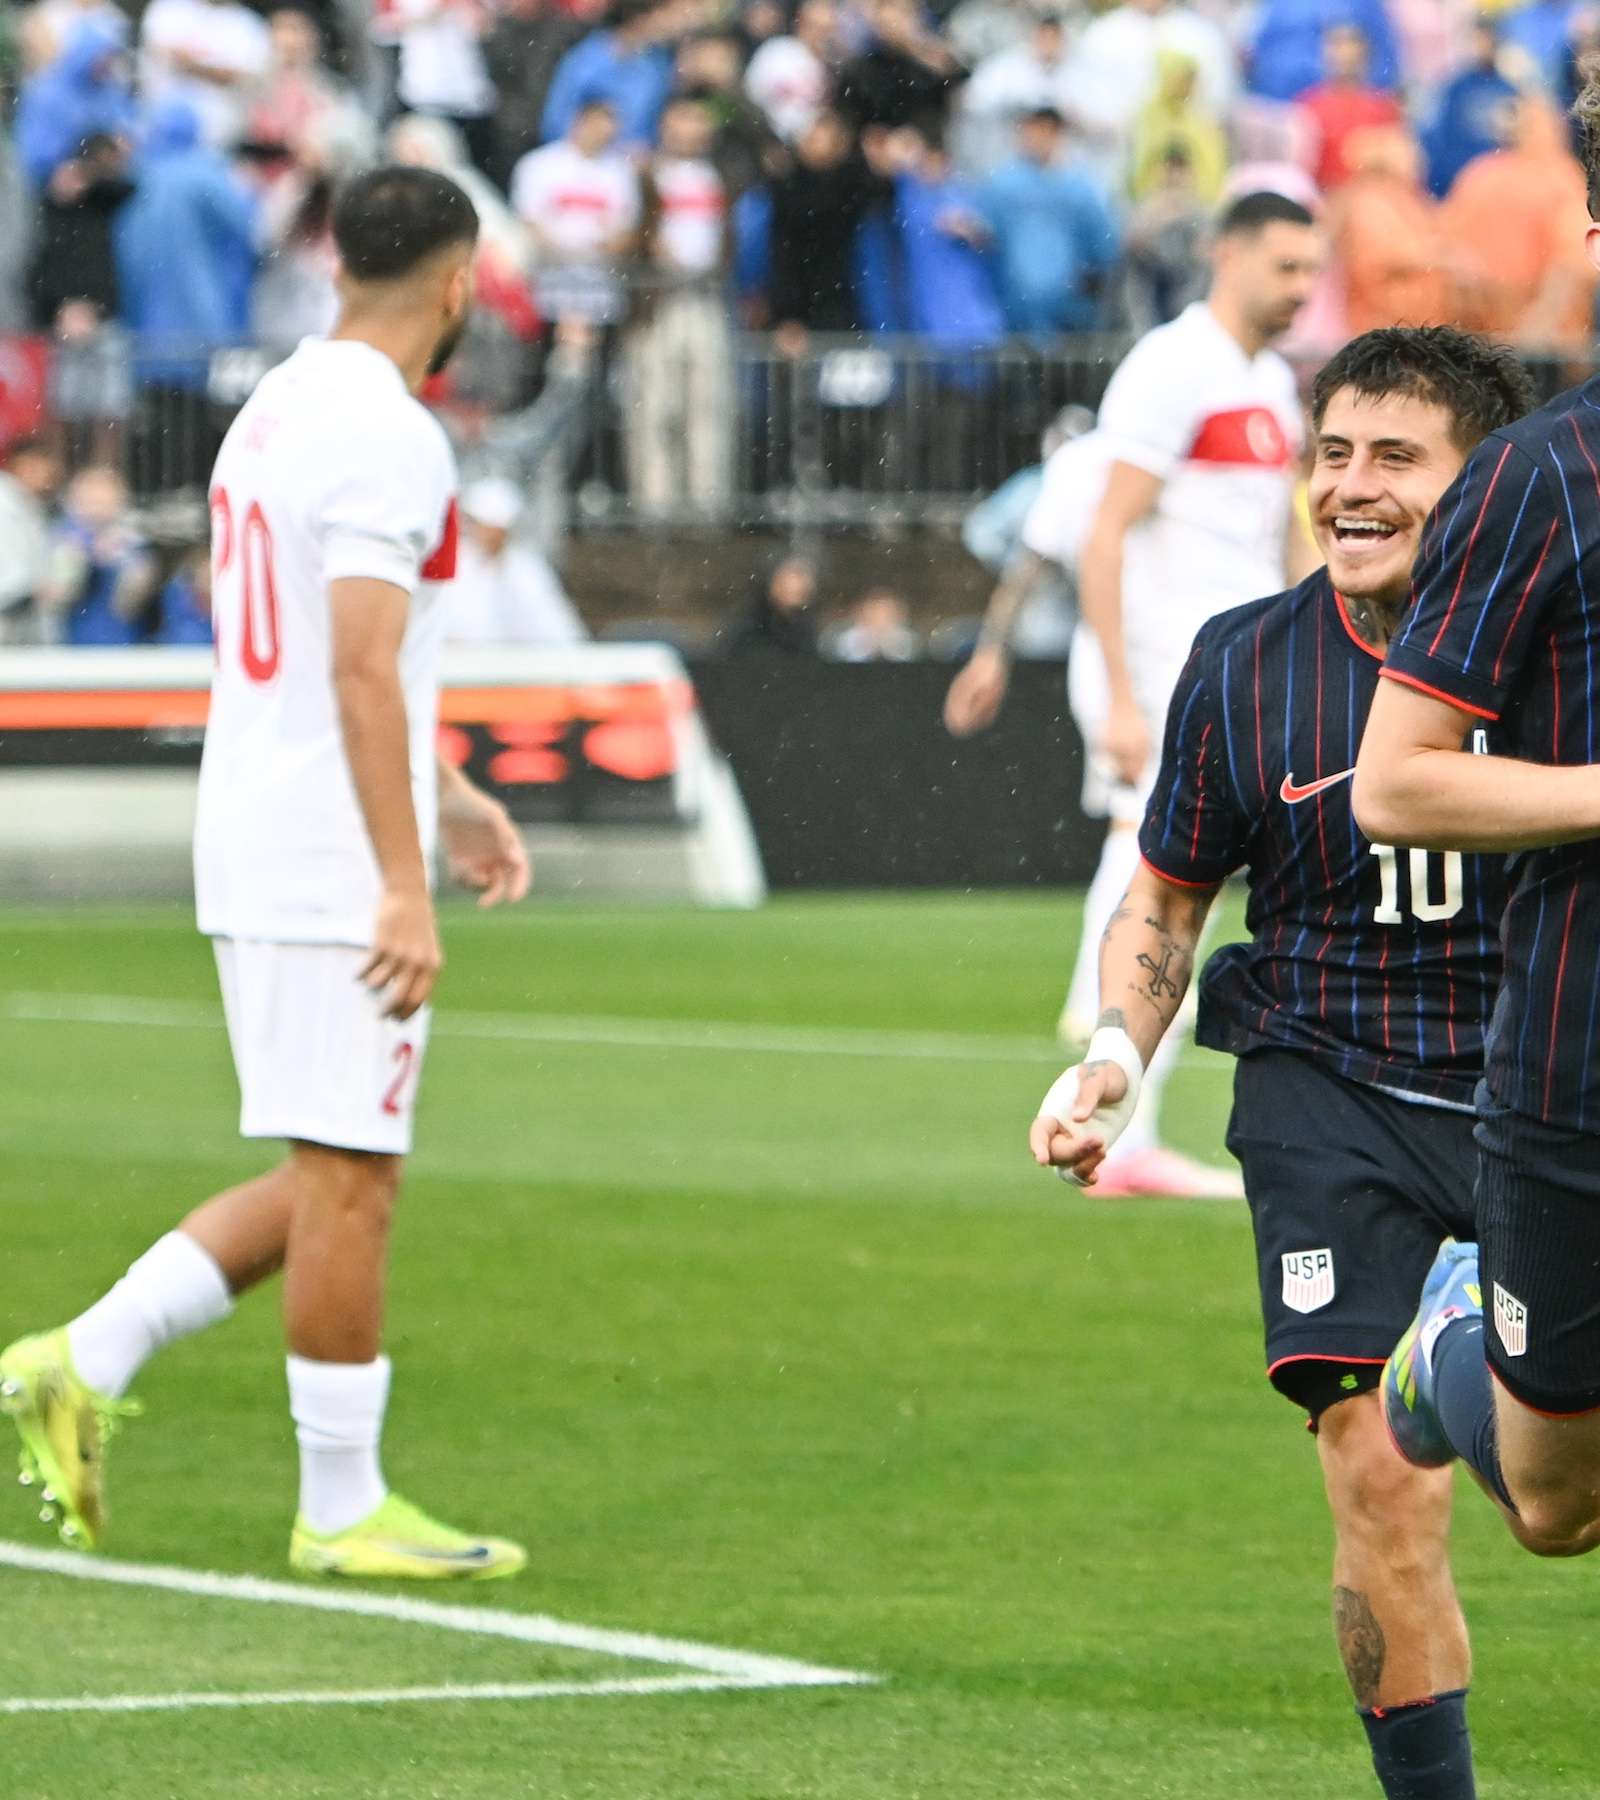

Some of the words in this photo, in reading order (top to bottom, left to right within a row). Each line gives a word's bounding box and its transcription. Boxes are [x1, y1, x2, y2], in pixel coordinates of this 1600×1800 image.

[1369, 843, 1464, 924] 10
[1286, 1253, 1328, 1280] USA
[1496, 1289, 1524, 1325] USA
